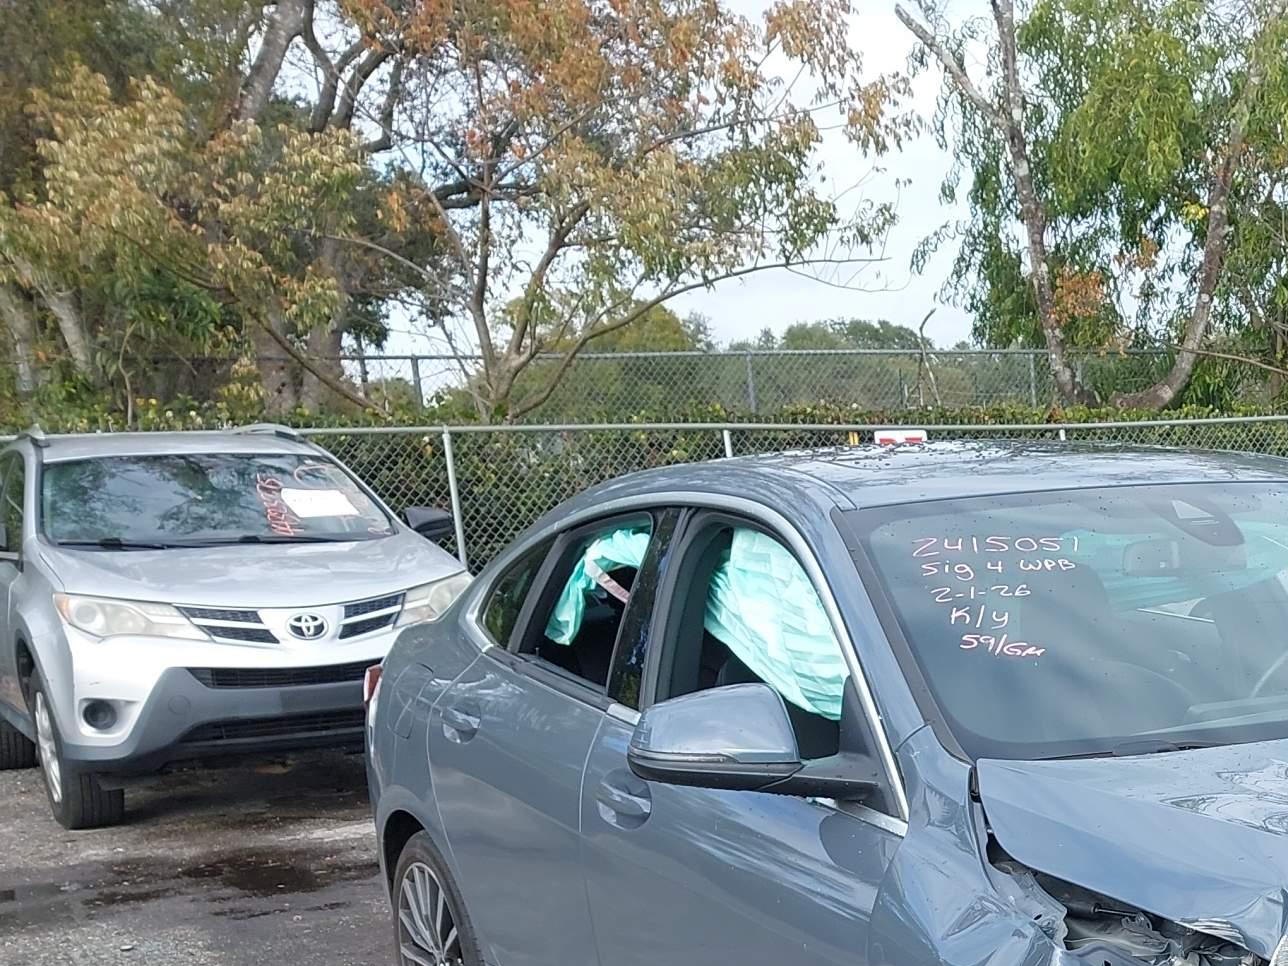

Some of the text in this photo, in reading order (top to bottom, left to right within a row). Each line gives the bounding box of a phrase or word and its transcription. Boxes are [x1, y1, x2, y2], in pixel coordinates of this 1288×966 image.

[912, 536, 1079, 557] 2415051
[987, 560, 1003, 573] 4
[930, 584, 1032, 603] 2-1-26
